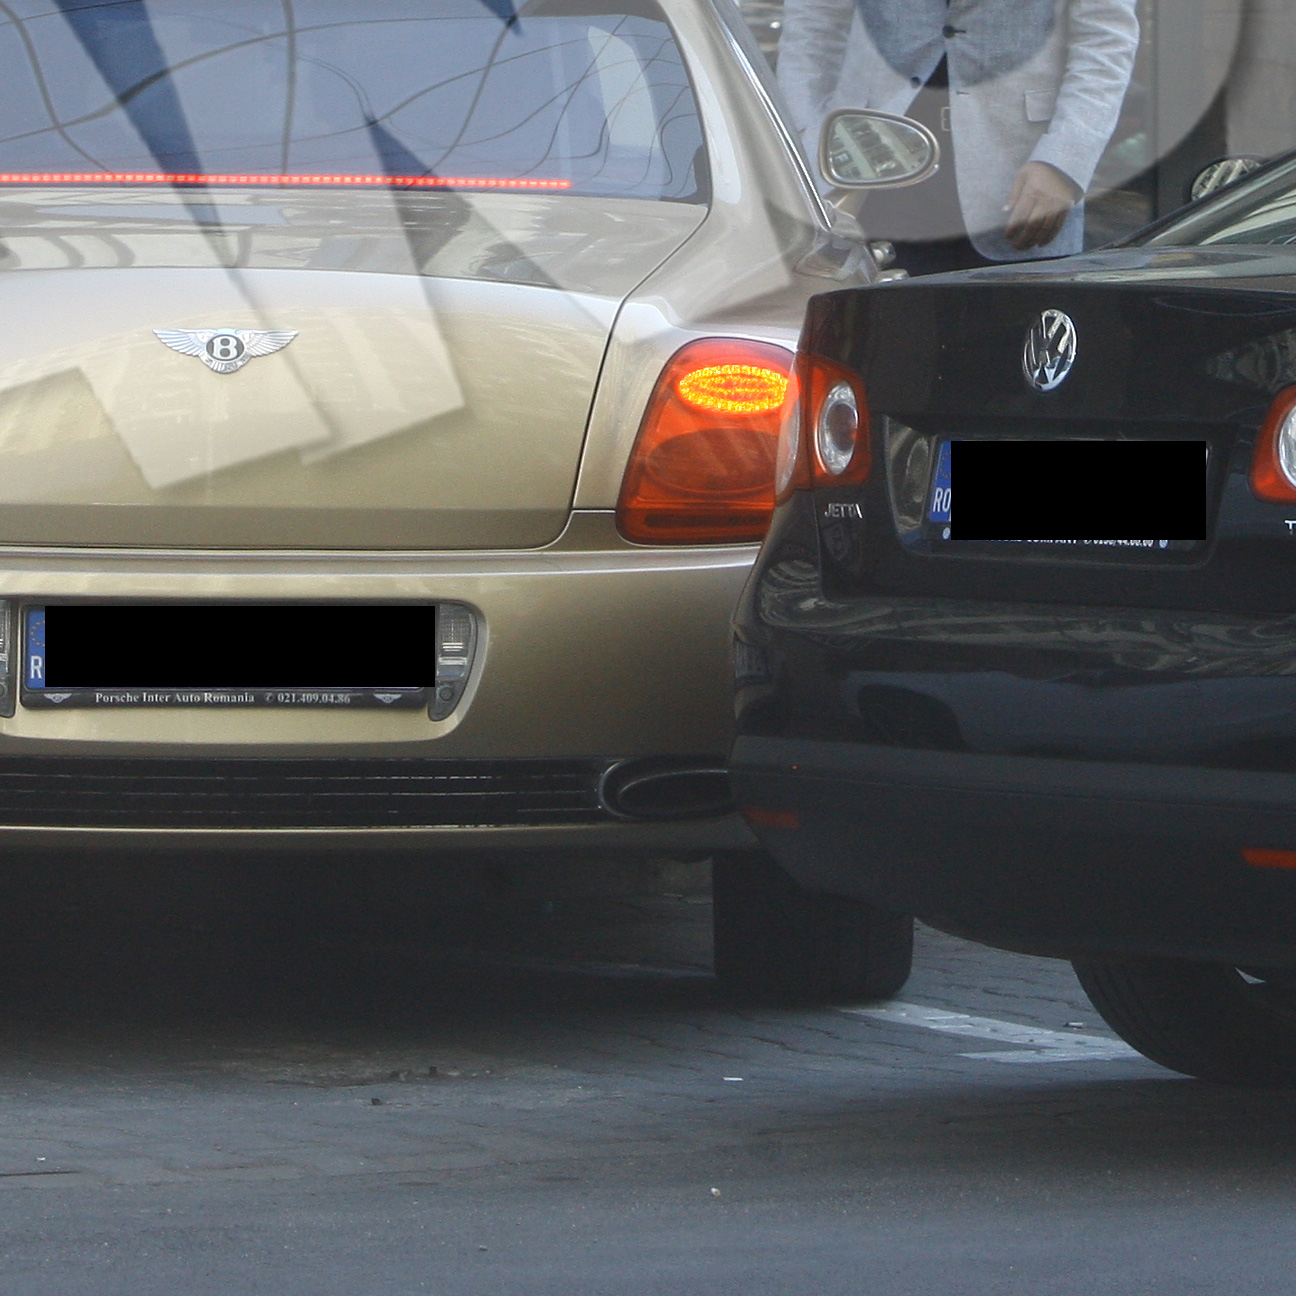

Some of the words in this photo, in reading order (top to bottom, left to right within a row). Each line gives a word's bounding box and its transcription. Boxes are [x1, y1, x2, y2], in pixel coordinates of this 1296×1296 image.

[212, 336, 238, 360] B
[824, 503, 863, 519] JETTA
[95, 691, 139, 703] Porsche
[143, 692, 171, 703] Inter
[173, 692, 201, 703] Auto
[204, 692, 255, 703] Romania
